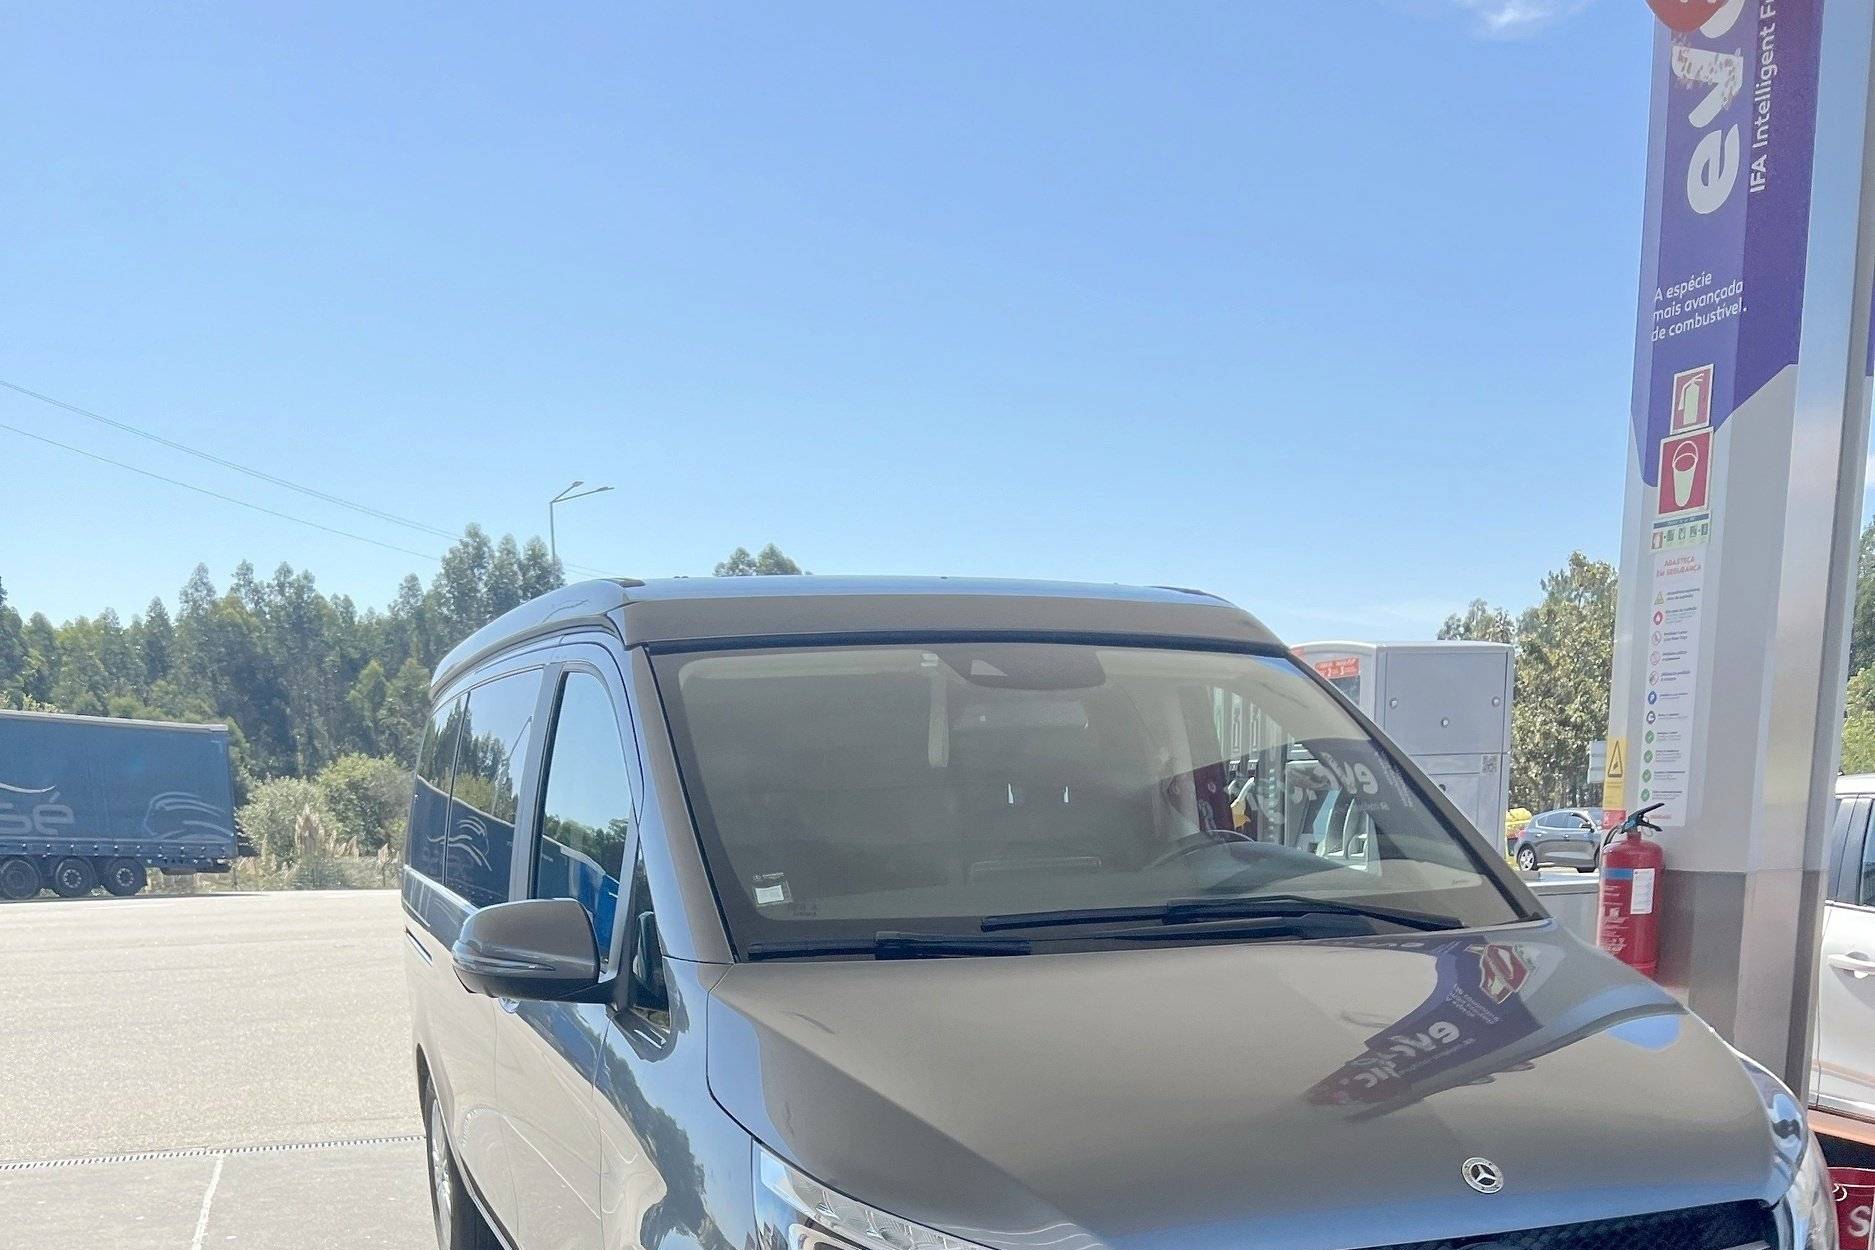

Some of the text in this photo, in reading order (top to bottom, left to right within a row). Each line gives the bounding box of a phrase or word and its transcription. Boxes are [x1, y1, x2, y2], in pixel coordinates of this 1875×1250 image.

[1671, 0, 1744, 214] ev
[1752, 22, 1778, 151] Intelligent
[1750, 153, 1768, 193] IFA
[1653, 279, 1744, 322] mais avançada
[1654, 271, 1712, 302] A espécie
[1651, 297, 1748, 341] de combustível.
